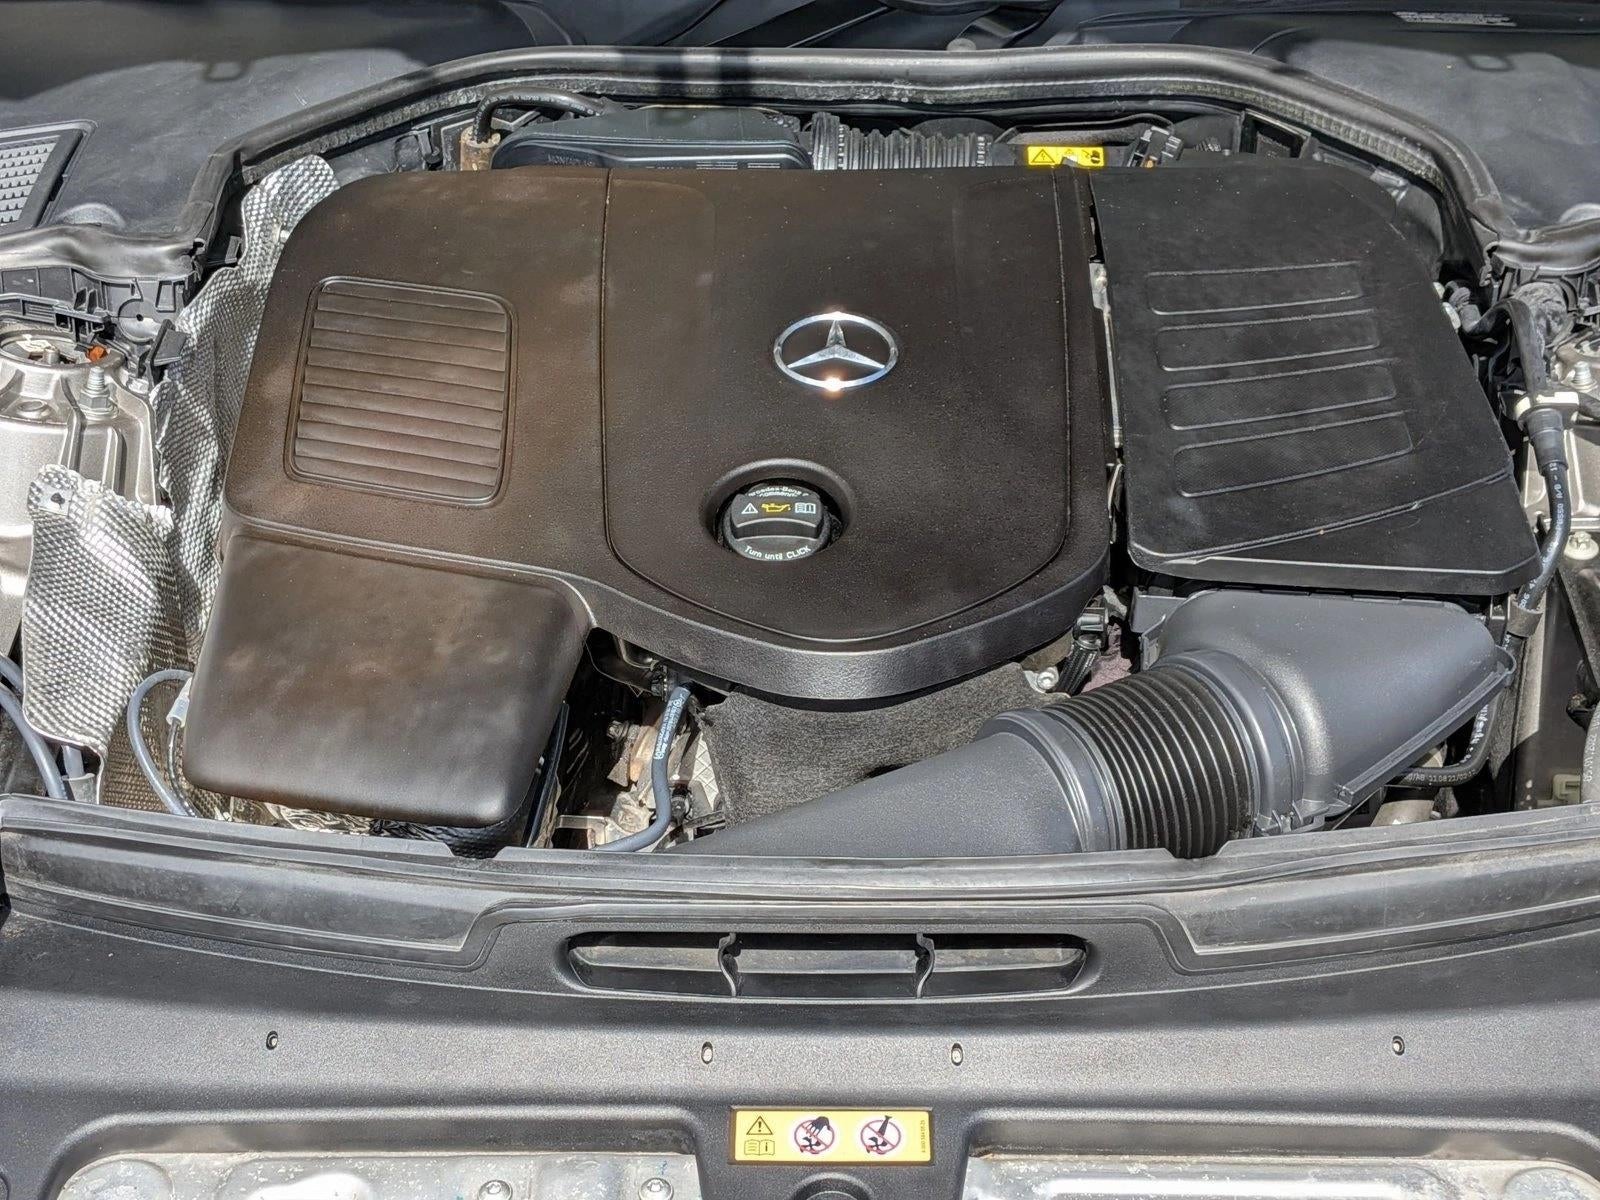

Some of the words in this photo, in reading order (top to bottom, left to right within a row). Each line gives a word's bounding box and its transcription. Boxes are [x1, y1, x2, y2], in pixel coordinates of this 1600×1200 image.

[744, 545, 762, 558] Turn
[764, 551, 783, 560] until
[786, 545, 812, 559] CLICK
